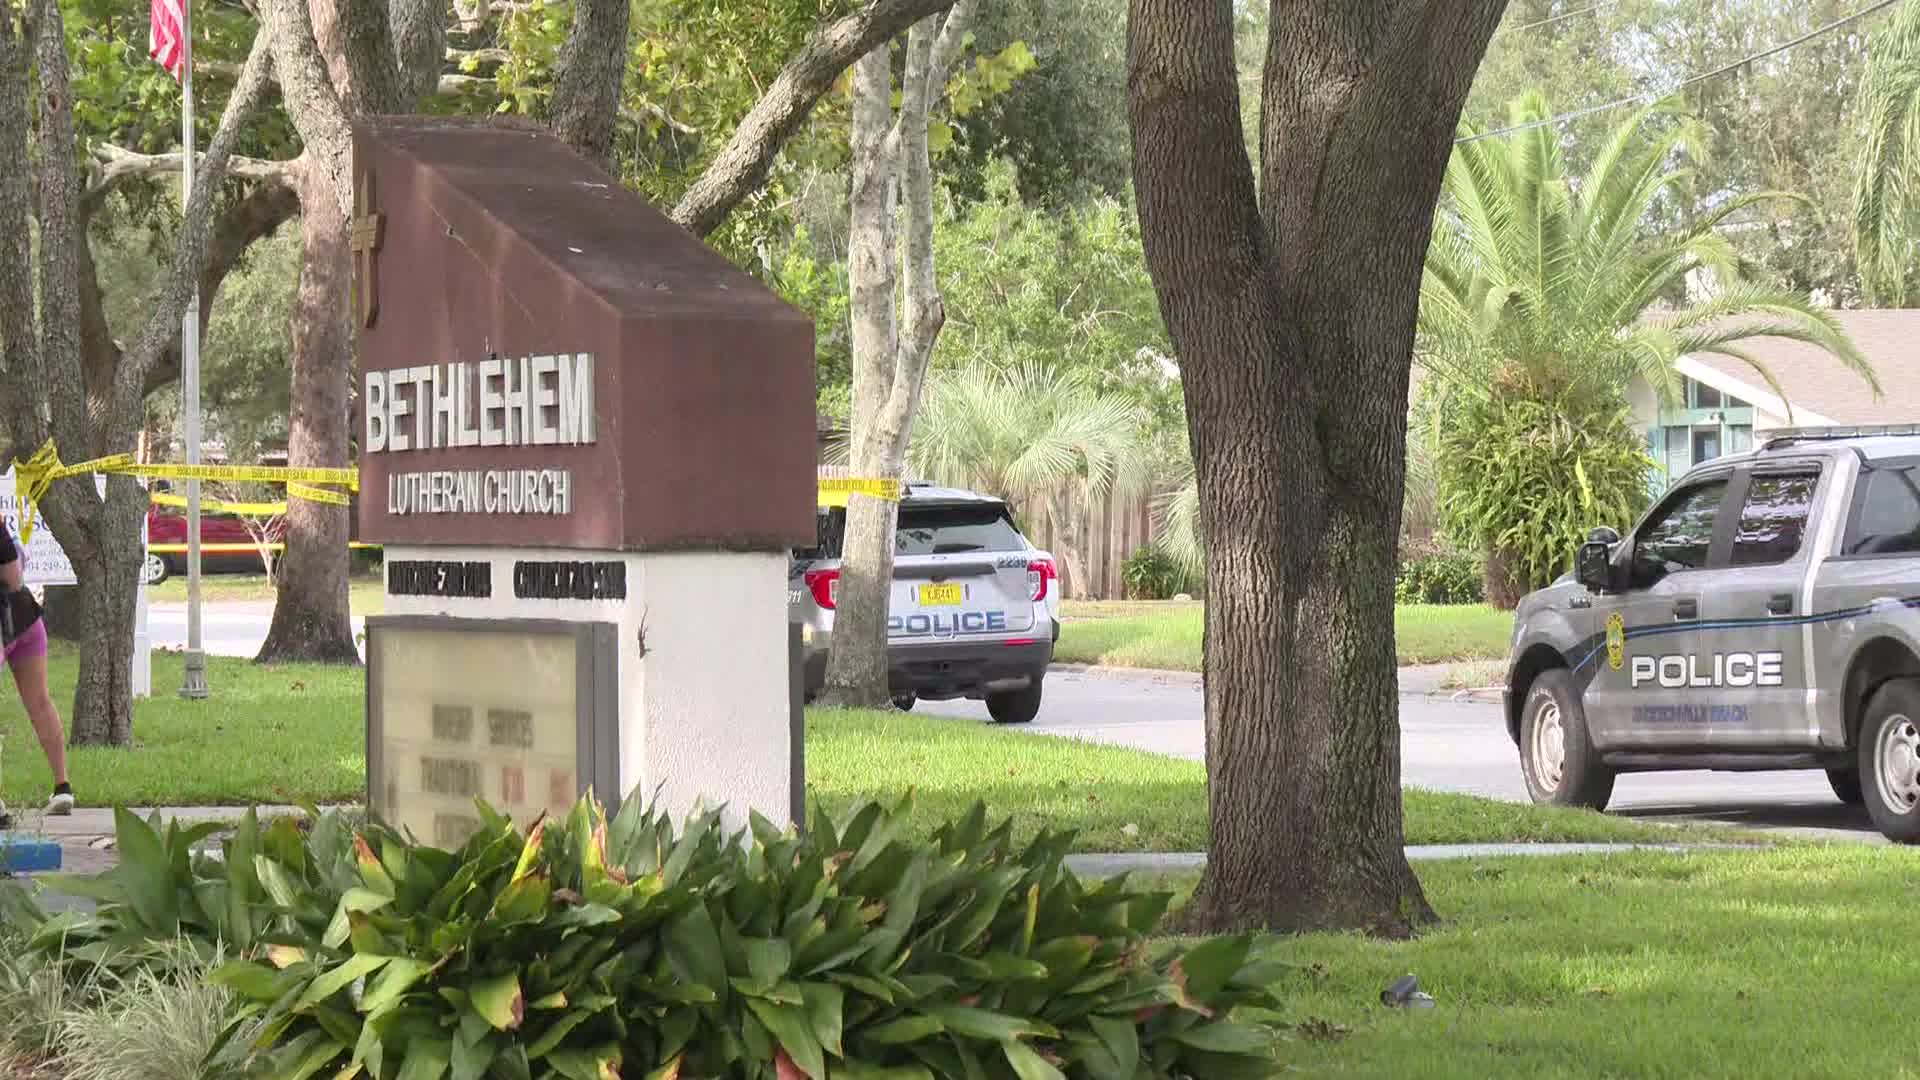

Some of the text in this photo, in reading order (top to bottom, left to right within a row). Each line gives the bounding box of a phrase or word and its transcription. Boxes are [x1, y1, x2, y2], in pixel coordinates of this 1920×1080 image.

[366, 353, 596, 452] BETHLEHEM
[387, 469, 570, 515] LUTHERAN CHURCH
[888, 611, 1006, 633] POLICE
[1631, 651, 1784, 688] POLICE
